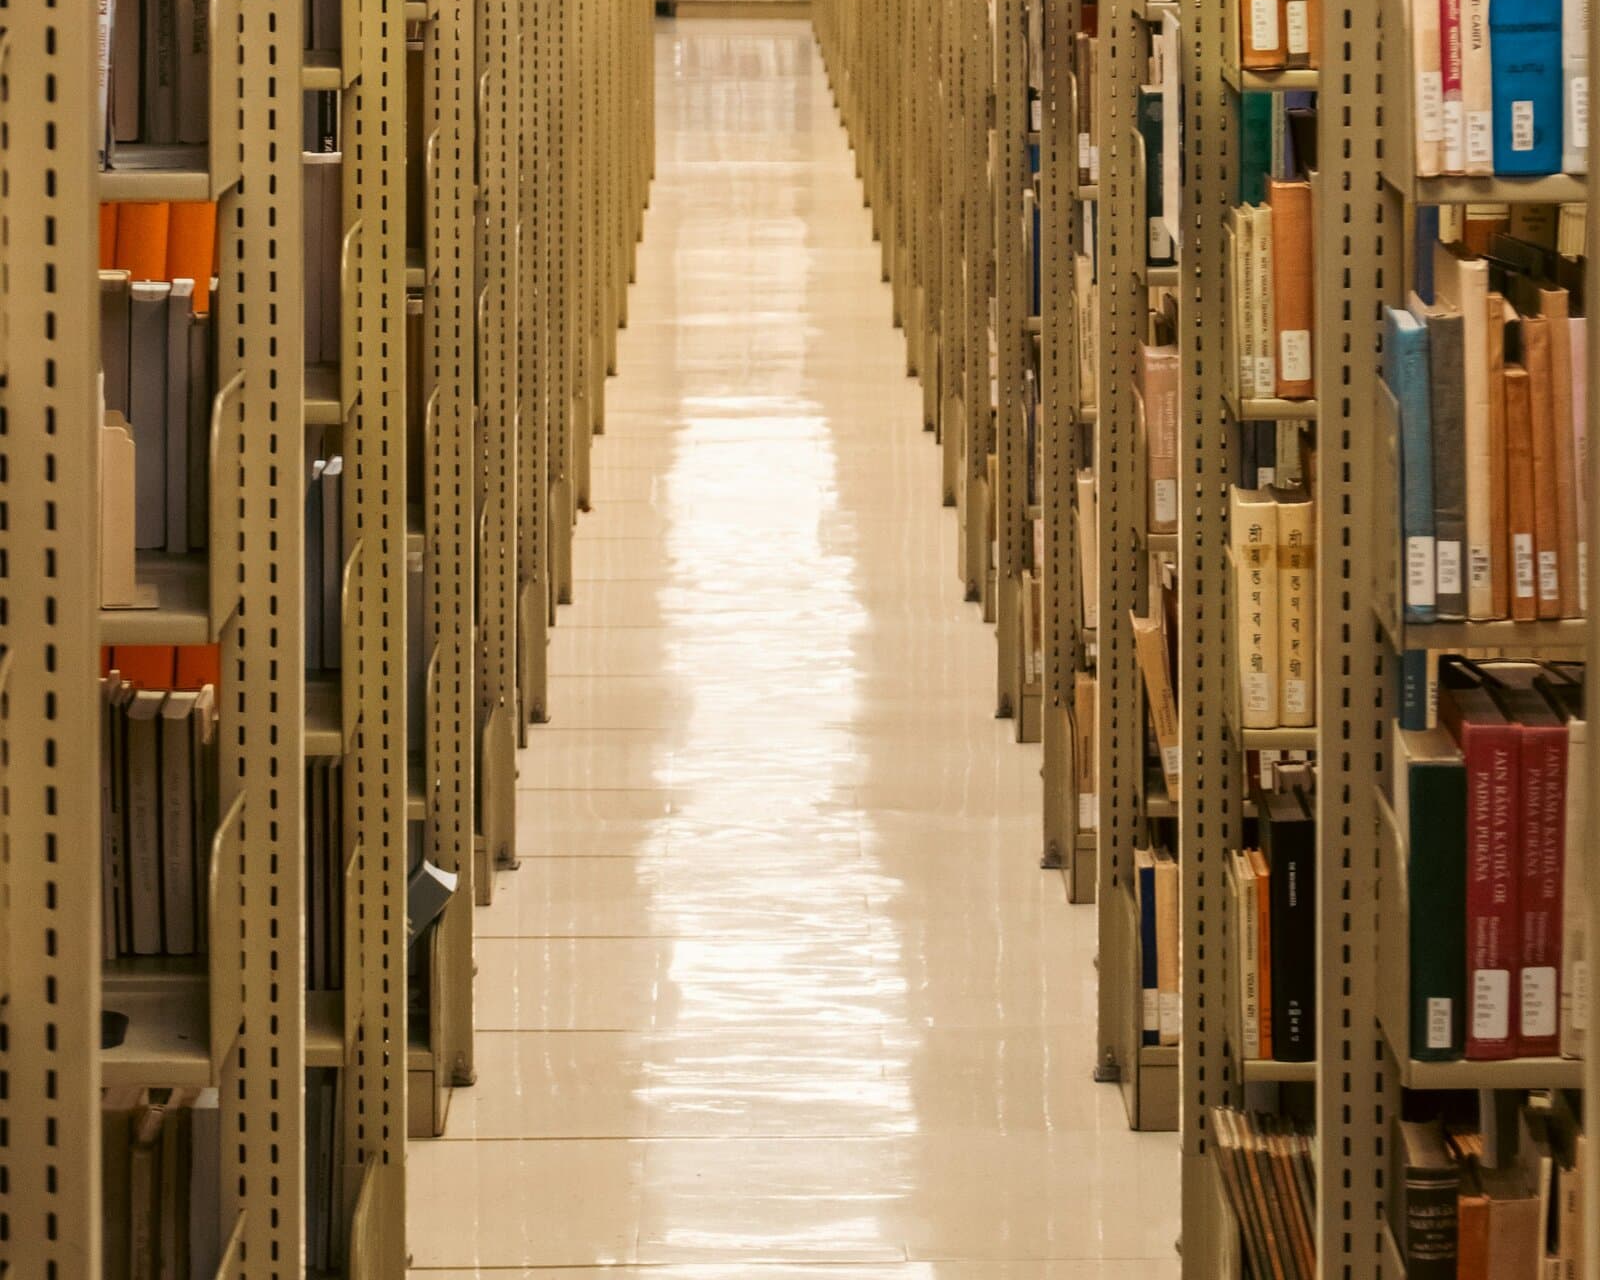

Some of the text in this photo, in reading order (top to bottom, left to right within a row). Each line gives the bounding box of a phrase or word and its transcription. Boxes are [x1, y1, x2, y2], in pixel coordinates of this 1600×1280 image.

[1493, 749, 1508, 781] JAIN
[1475, 771, 1489, 821] PADMA
[1492, 883, 1506, 905] OR
